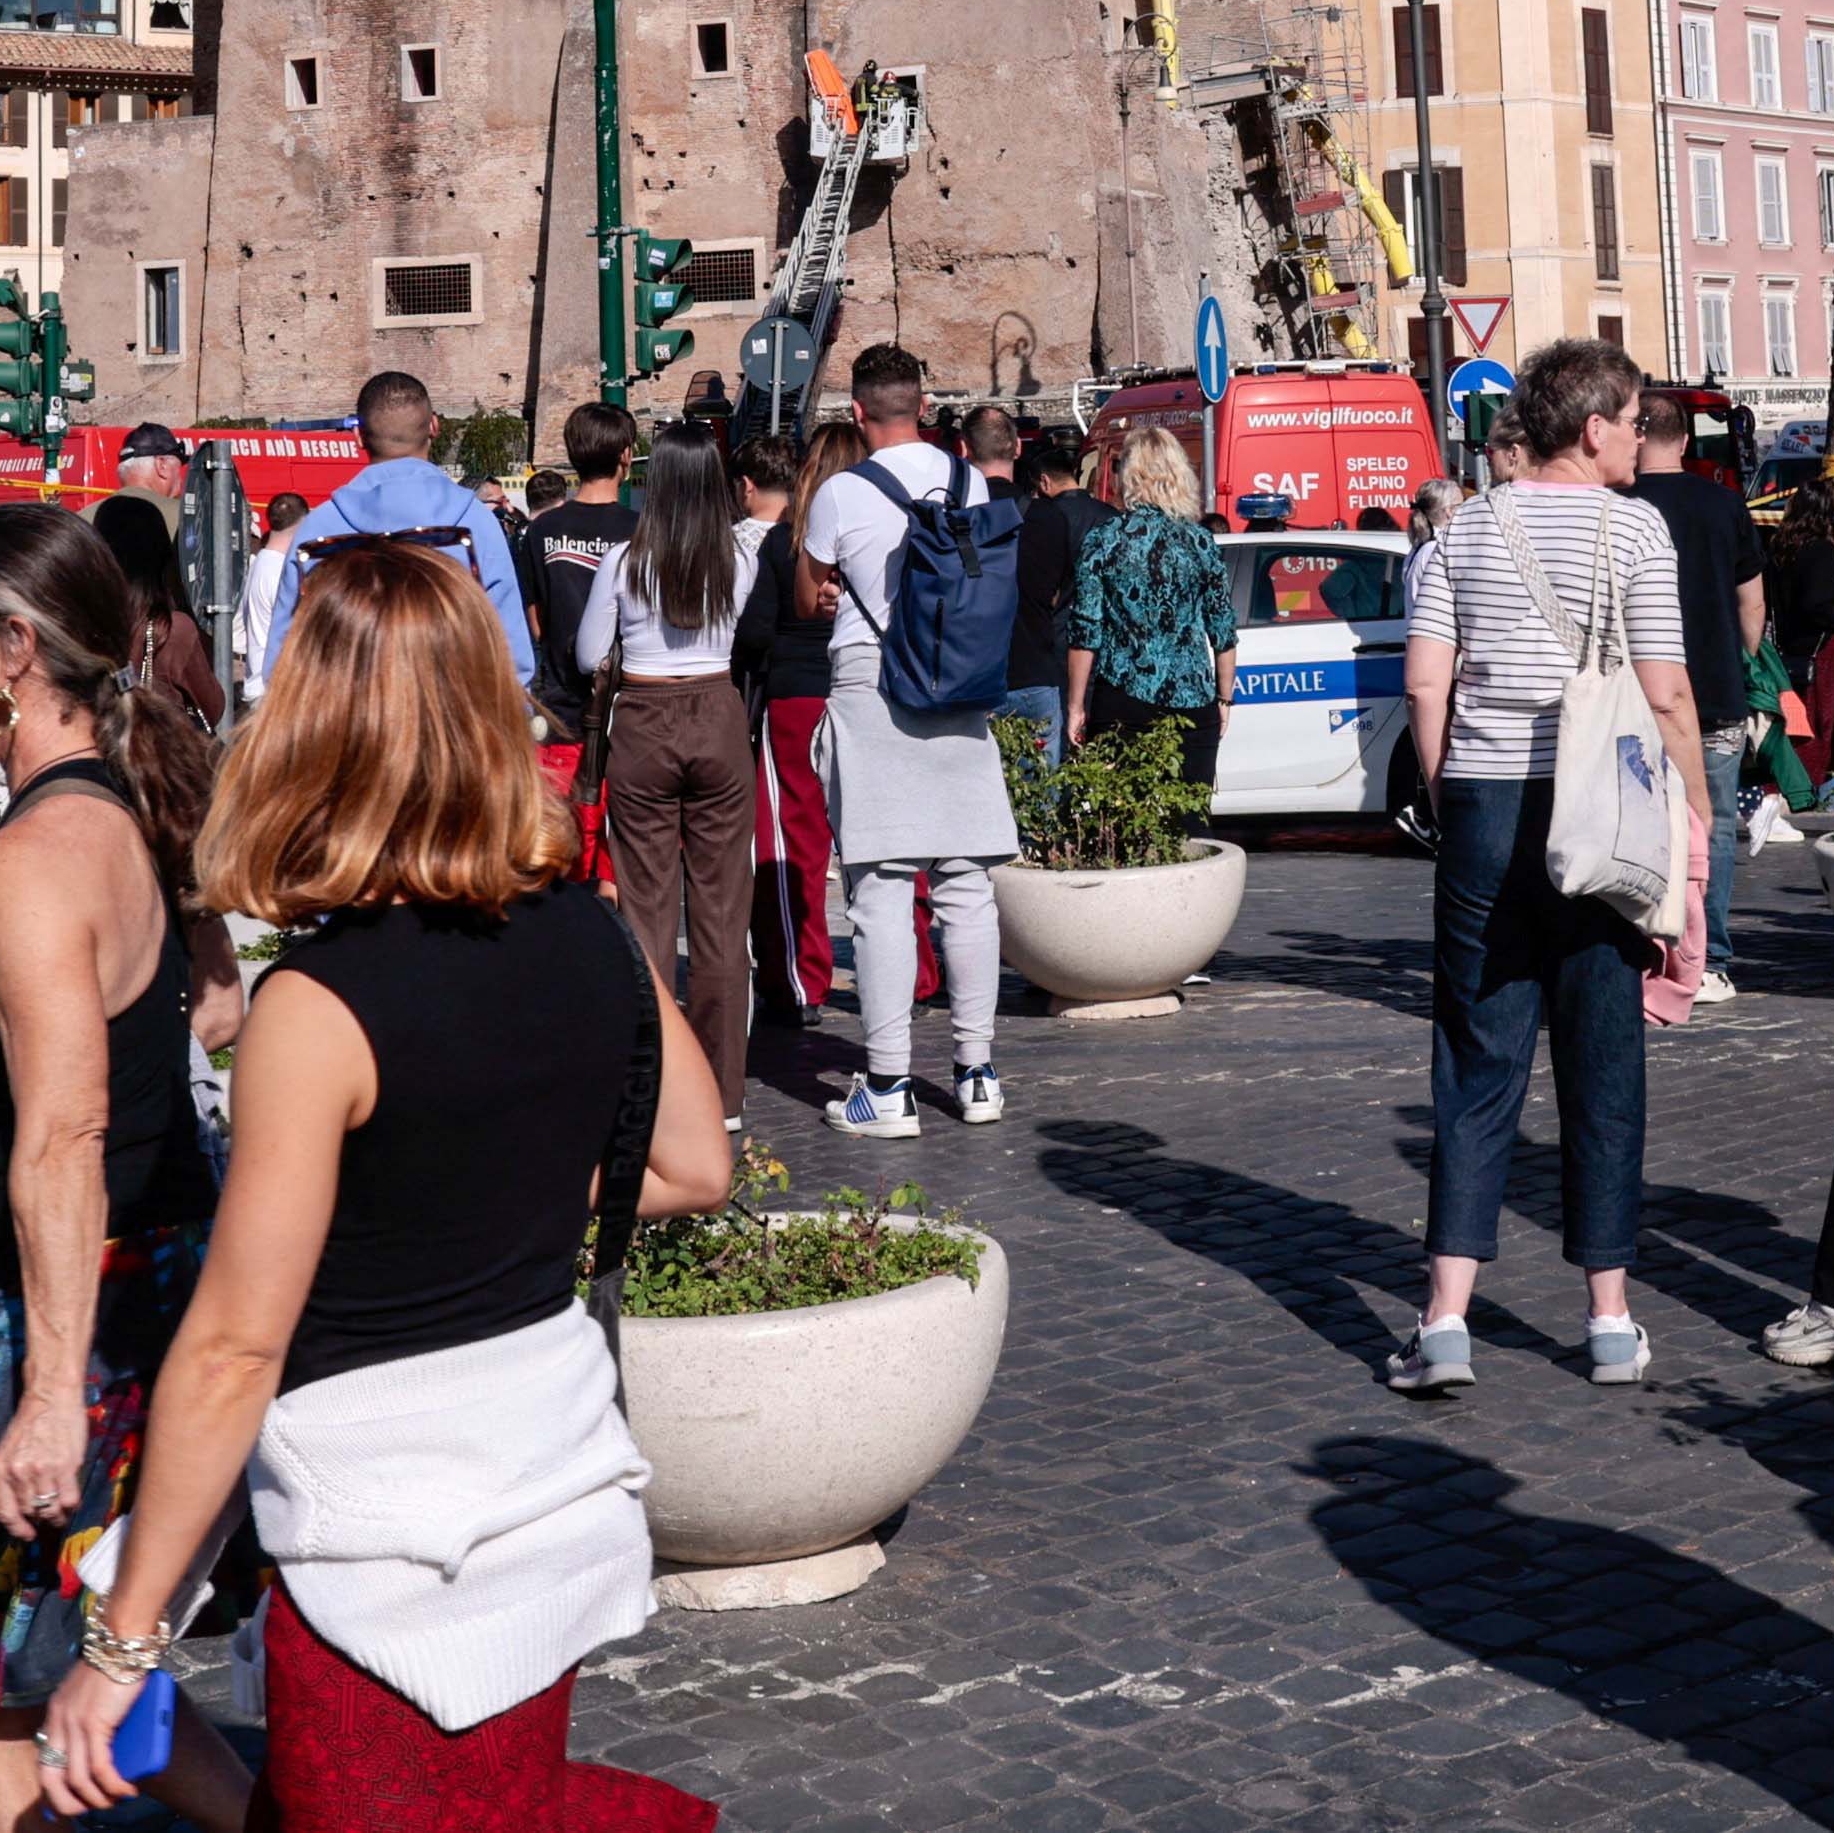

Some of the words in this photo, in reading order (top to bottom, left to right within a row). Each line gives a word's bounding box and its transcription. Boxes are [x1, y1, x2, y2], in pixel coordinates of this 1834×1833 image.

[1765, 387, 1826, 405] MASSENZIO
[1247, 406, 1414, 429] www.vigilfuoco.it
[266, 438, 297, 457] AND
[300, 440, 359, 458] RESCUE
[1346, 457, 1408, 472] SPELEO
[1252, 472, 1320, 501] SAF
[1347, 475, 1406, 491] ALPINO
[1348, 494, 1417, 509] FLUVIAL
[543, 534, 616, 554] Balencia
[1305, 556, 1338, 572] 115
[1232, 670, 1326, 696] APITALE
